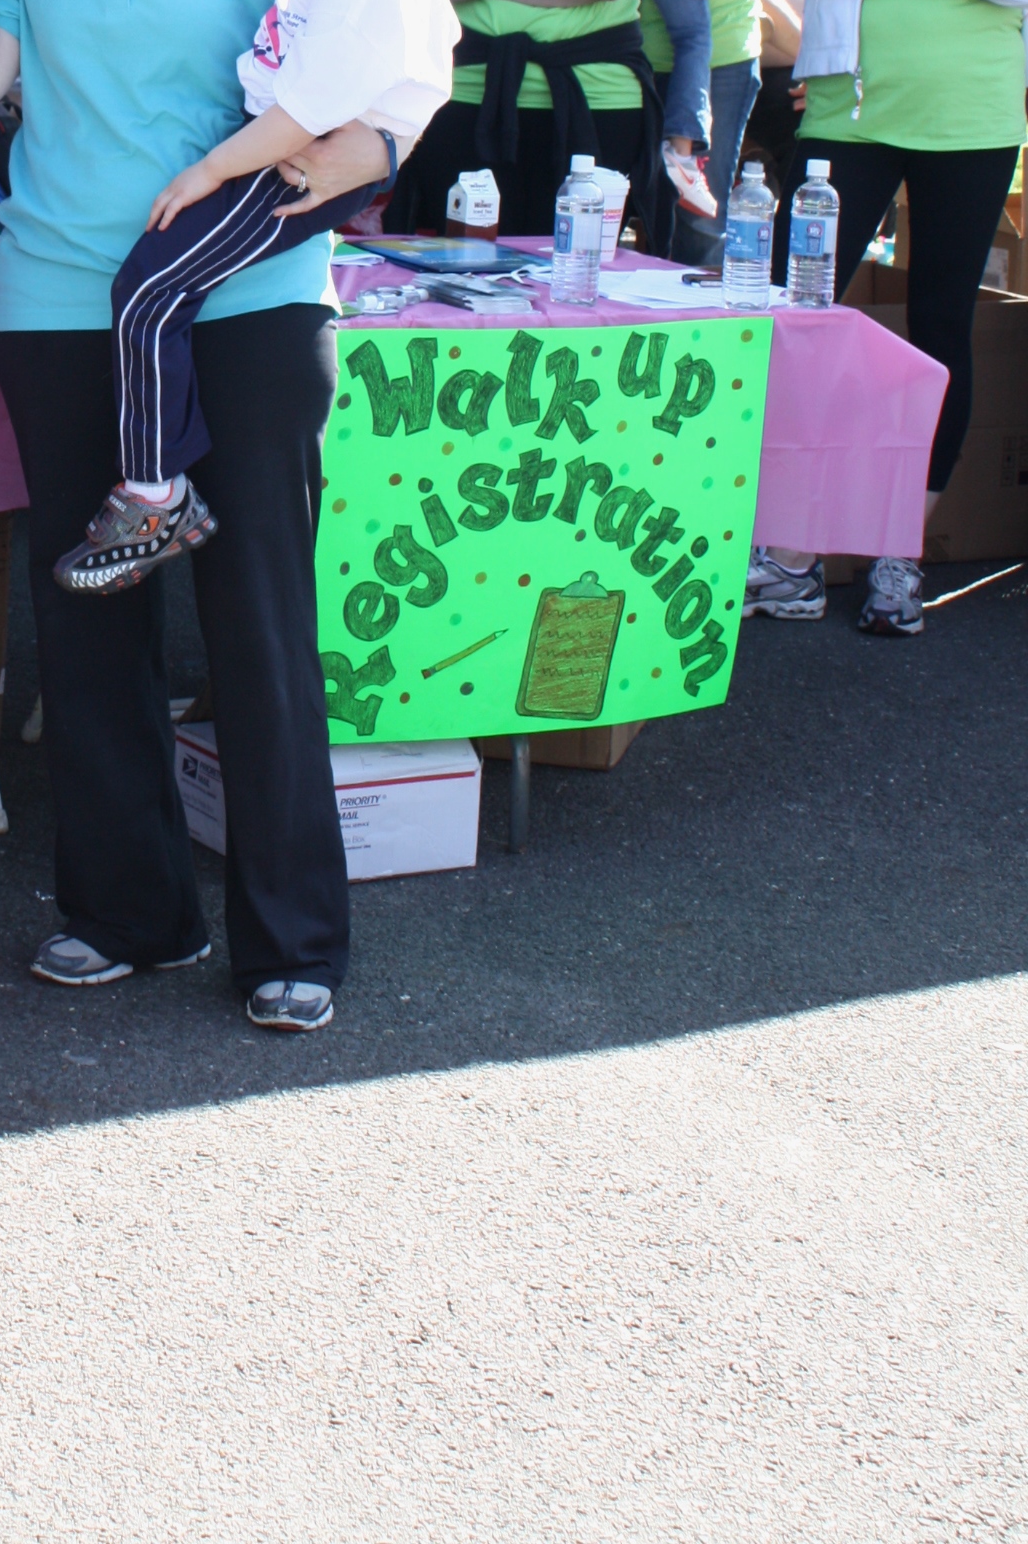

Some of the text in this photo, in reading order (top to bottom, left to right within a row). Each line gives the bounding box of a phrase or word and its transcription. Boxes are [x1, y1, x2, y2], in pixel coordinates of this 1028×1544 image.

[346, 329, 601, 444] Walk
[320, 447, 729, 737] Registration
[340, 794, 382, 807] PRIORITY
